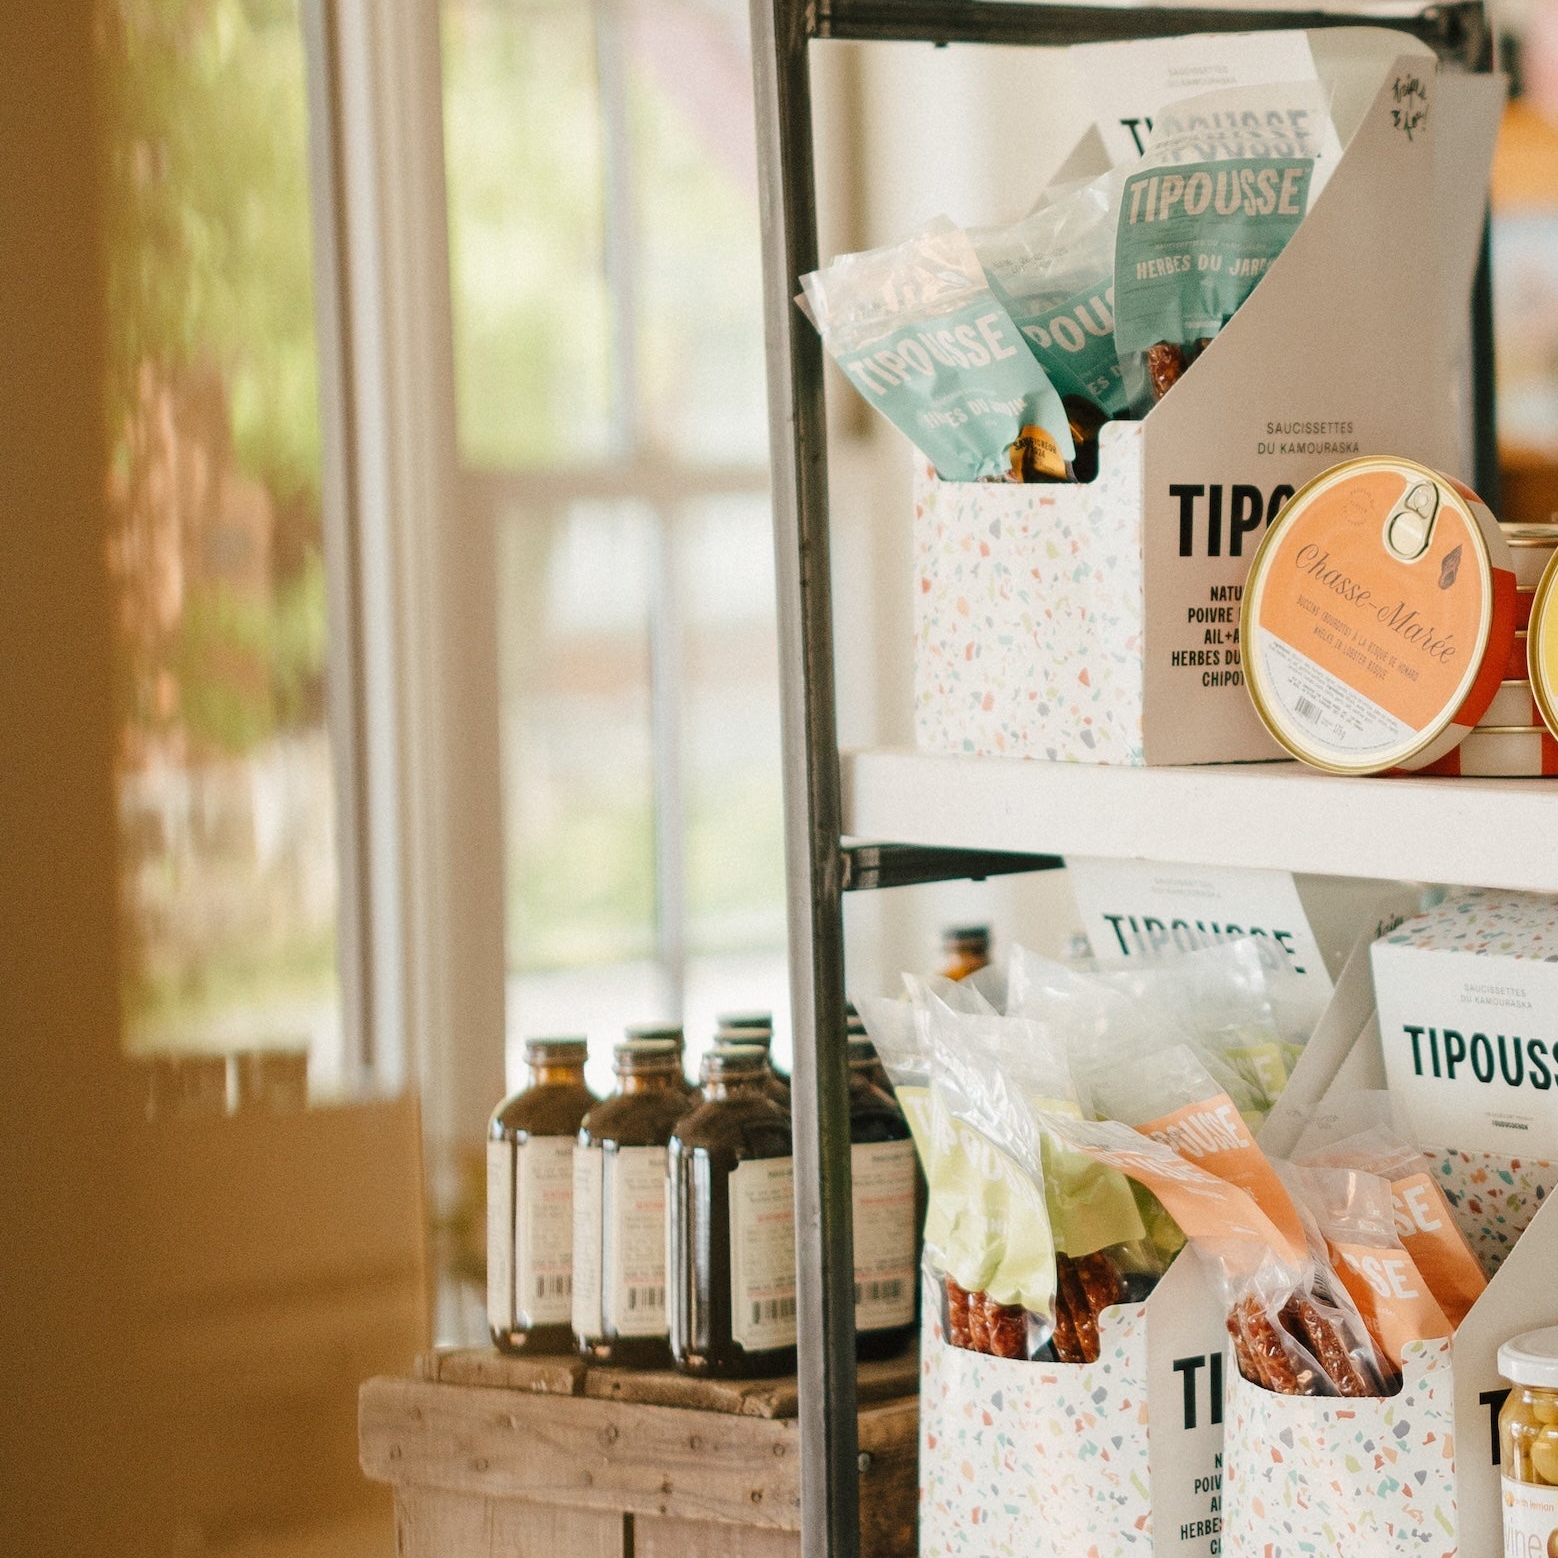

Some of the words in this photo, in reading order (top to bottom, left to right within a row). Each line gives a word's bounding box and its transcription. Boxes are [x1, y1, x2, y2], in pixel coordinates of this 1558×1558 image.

[1129, 167, 1305, 225] TIPOUSSE
[1137, 254, 1191, 280] HERBES
[1198, 253, 1222, 273] DU
[847, 312, 1018, 396] TIPOUSSE
[1267, 422, 1353, 434] SAUCISSETTES
[1258, 443, 1275, 454] DU
[1280, 442, 1359, 454] KAMOURASKA
[1296, 543, 1455, 664] Chasse-Marée
[1188, 607, 1233, 623] POIVRE
[1172, 650, 1220, 666] HERBES
[1225, 651, 1241, 665] DU
[1464, 984, 1526, 997] SAUCISSETTES
[1460, 995, 1472, 1003] DU
[1475, 996, 1533, 1010] KAMOURASKA
[1173, 1352, 1222, 1430] TI
[1531, 1500, 1554, 1512] lemon
